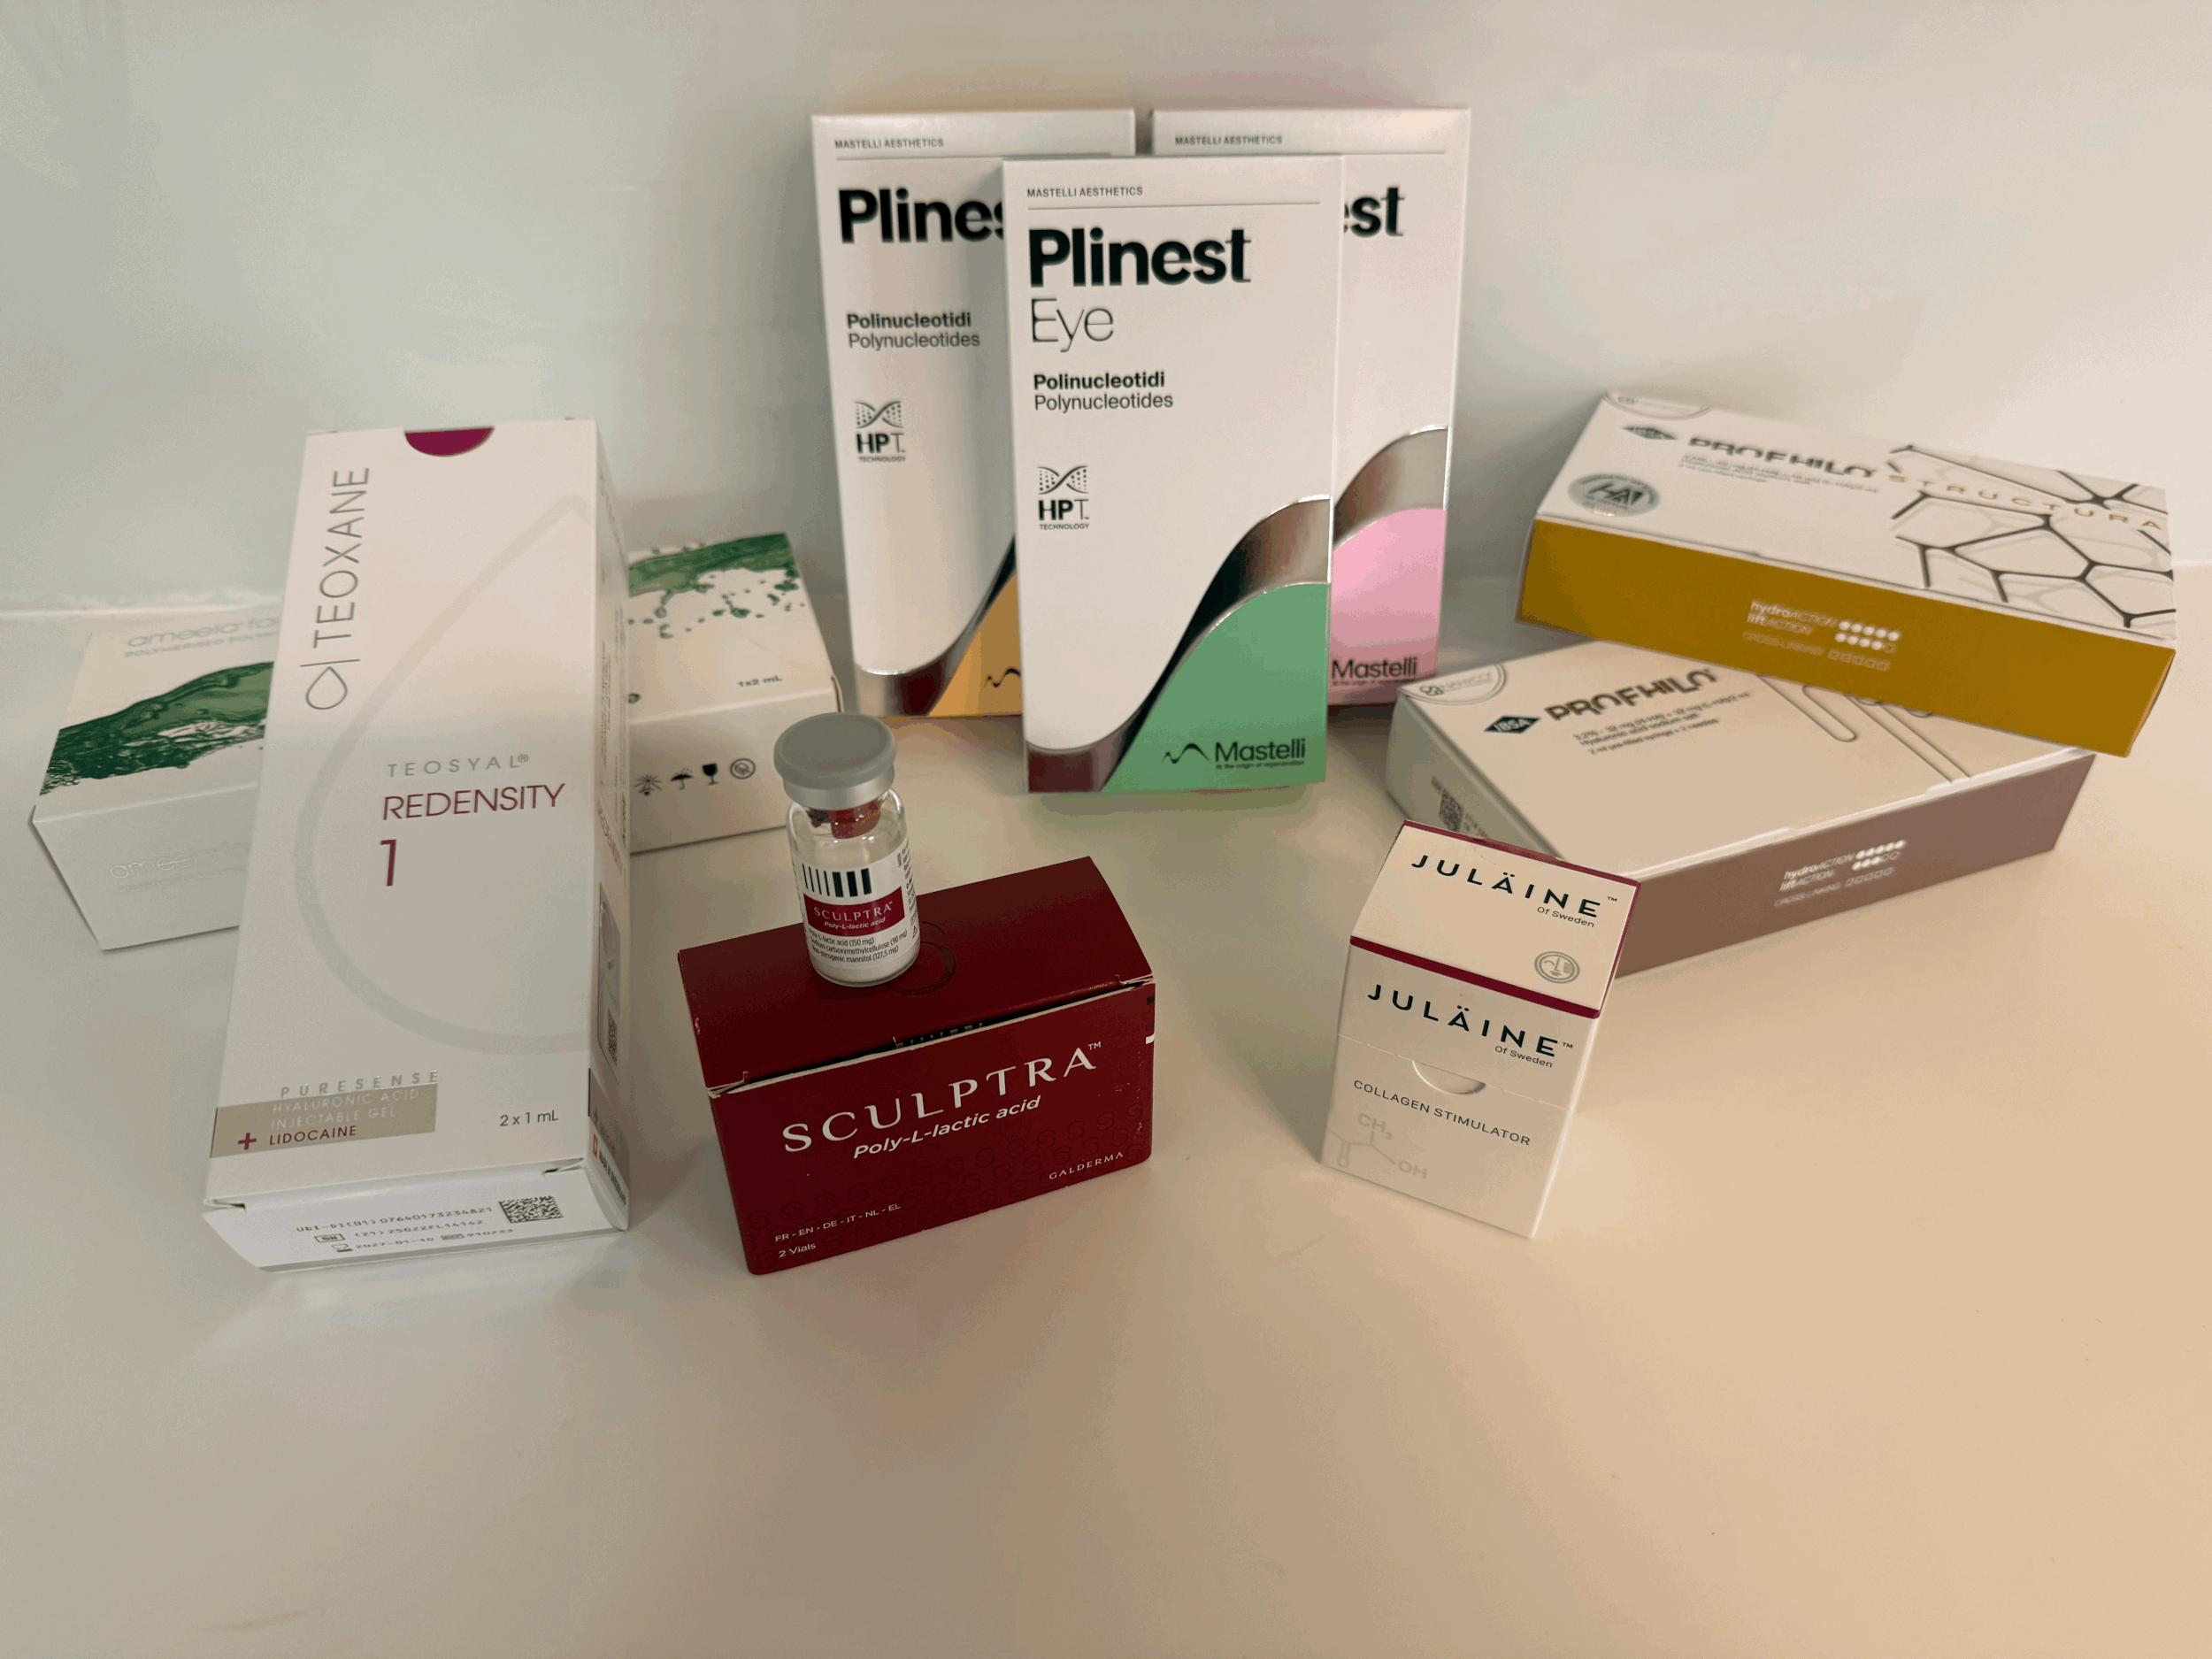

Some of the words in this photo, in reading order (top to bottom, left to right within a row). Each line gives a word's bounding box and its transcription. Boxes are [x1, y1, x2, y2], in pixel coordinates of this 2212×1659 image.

[834, 139, 881, 150] MASTELLI
[885, 138, 944, 149] AESTHETICS
[1174, 135, 1221, 146] MASTELLI
[1224, 134, 1282, 145] AESTHETICS
[1027, 188, 1077, 198] MASTELLI
[1079, 186, 1143, 196] AESTHETICS
[1029, 227, 1251, 288] Plinest
[847, 311, 972, 329] Polinucleotidi
[1032, 298, 1114, 353] Eye
[848, 331, 980, 351] Polynucleotides
[1033, 372, 1165, 390] Polinucleotidi
[1034, 393, 1173, 413] Polynucleotides
[1888, 473, 2162, 531] STRUCTURA
[313, 467, 370, 649] TEOXANE
[1331, 657, 1418, 680] Mastelli
[1493, 718, 1532, 733] IBSA
[1215, 737, 1306, 763] Mastelli
[388, 754, 529, 778] TEOSYAL®
[383, 783, 565, 820] REDENSITY
[380, 839, 396, 887] 1
[824, 920, 869, 930] Poly-L-lactic
[870, 916, 887, 926] acid
[1537, 906, 1550, 915] Of
[1551, 910, 1595, 928] Sweden
[836, 938, 849, 947] acid
[862, 936, 875, 946] mg)
[889, 935, 899, 947] (90
[898, 929, 908, 940] mg)
[846, 953, 872, 963] mannitol
[887, 944, 899, 954] mg)
[1494, 1045, 1509, 1055] Of
[1509, 1048, 1554, 1069] Sweden
[280, 1070, 438, 1099] PURESENSE
[273, 1093, 373, 1115] HYALURONIC
[380, 1088, 420, 1103] ACID
[1353, 1079, 1431, 1114] COLLAGEN
[1433, 1107, 1532, 1147] STIMULATOR
[271, 1110, 361, 1130] INJECTABLE
[368, 1106, 396, 1119] GEL
[499, 1114, 509, 1127] 2
[511, 1117, 520, 1125] x
[525, 1112, 531, 1124] 1
[537, 1110, 559, 1123] mL
[853, 1111, 990, 1160] Poly-L-lactic
[995, 1094, 1041, 1119] acid
[269, 1125, 357, 1146] LIDOCAINE
[1048, 1151, 1125, 1180] GALDERMA
[775, 1233, 790, 1242] FR
[799, 1226, 814, 1236] EN
[823, 1219, 838, 1230] DE
[847, 1214, 856, 1224] IT
[864, 1210, 879, 1218] NL
[887, 1202, 902, 1211] EL
[779, 1249, 787, 1258] 2
[788, 1242, 817, 1256] Vials
